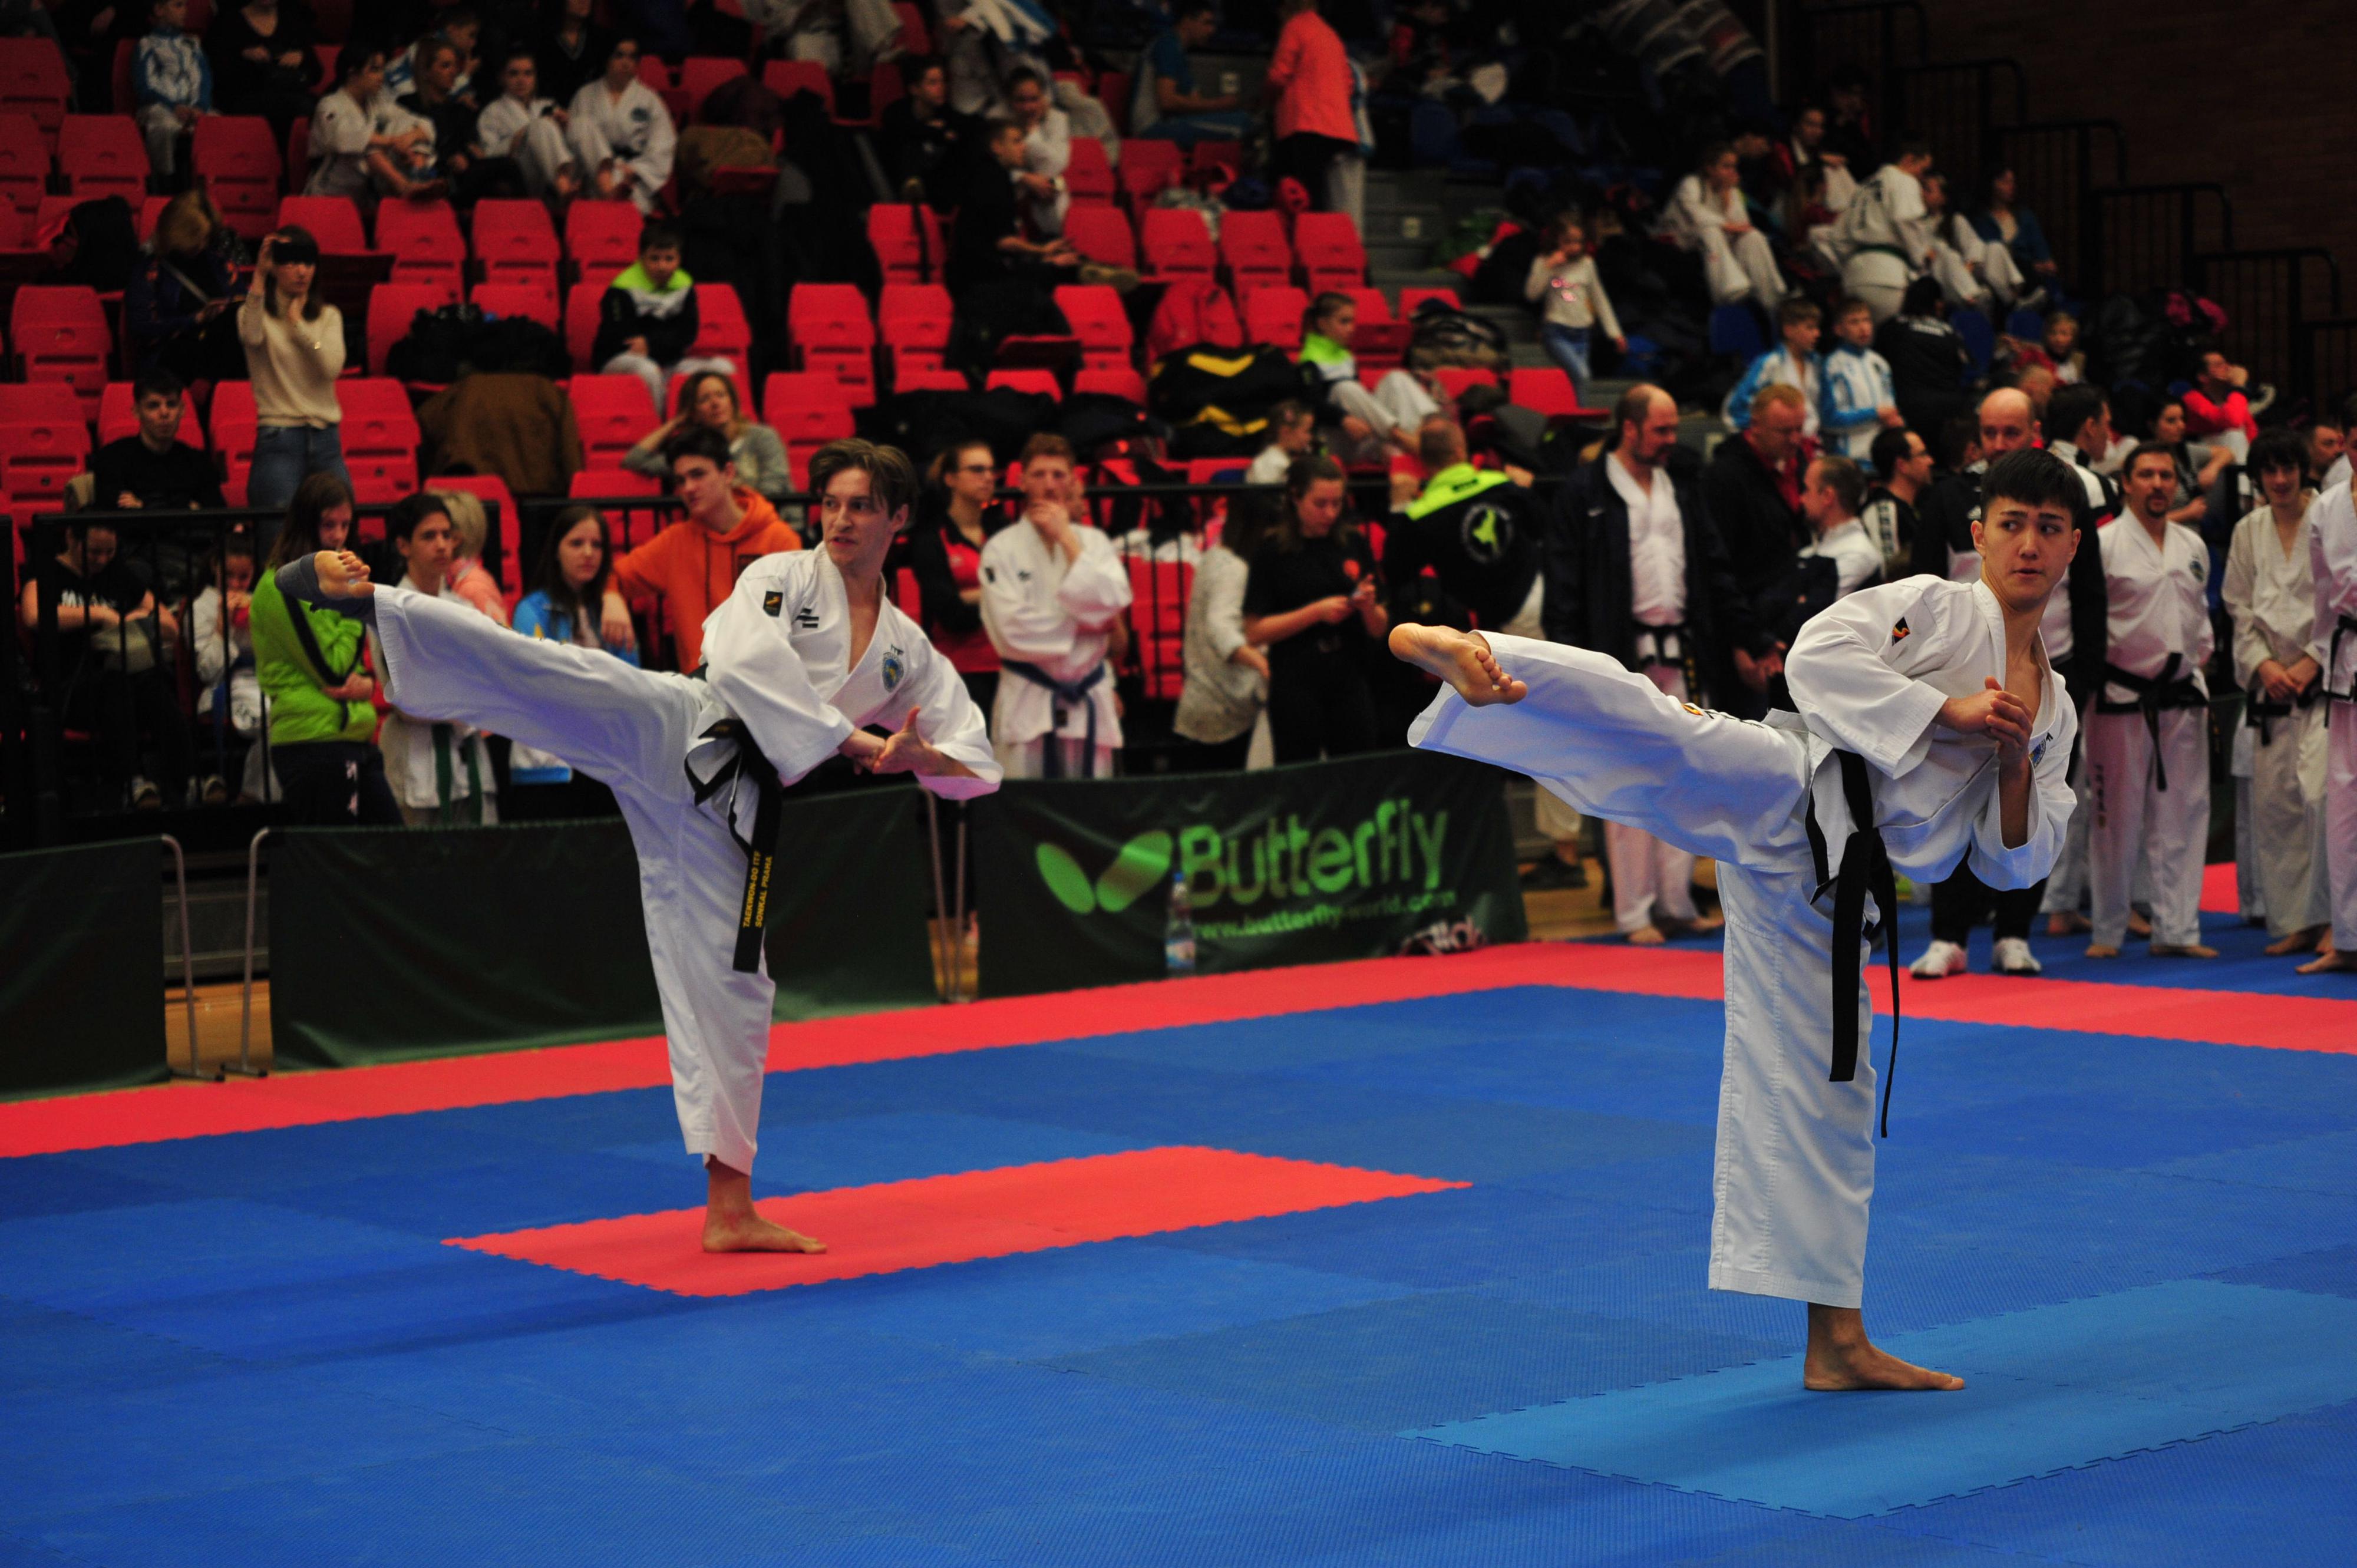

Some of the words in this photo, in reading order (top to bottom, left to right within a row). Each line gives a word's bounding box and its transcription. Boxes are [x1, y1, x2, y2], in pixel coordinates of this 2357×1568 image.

[761, 856, 773, 888] PRAHA
[1180, 797, 1450, 908] Butterfly
[742, 867, 760, 927] TAEKWON-DO
[753, 850, 761, 866] ITF
[755, 890, 768, 927] SONKAL
